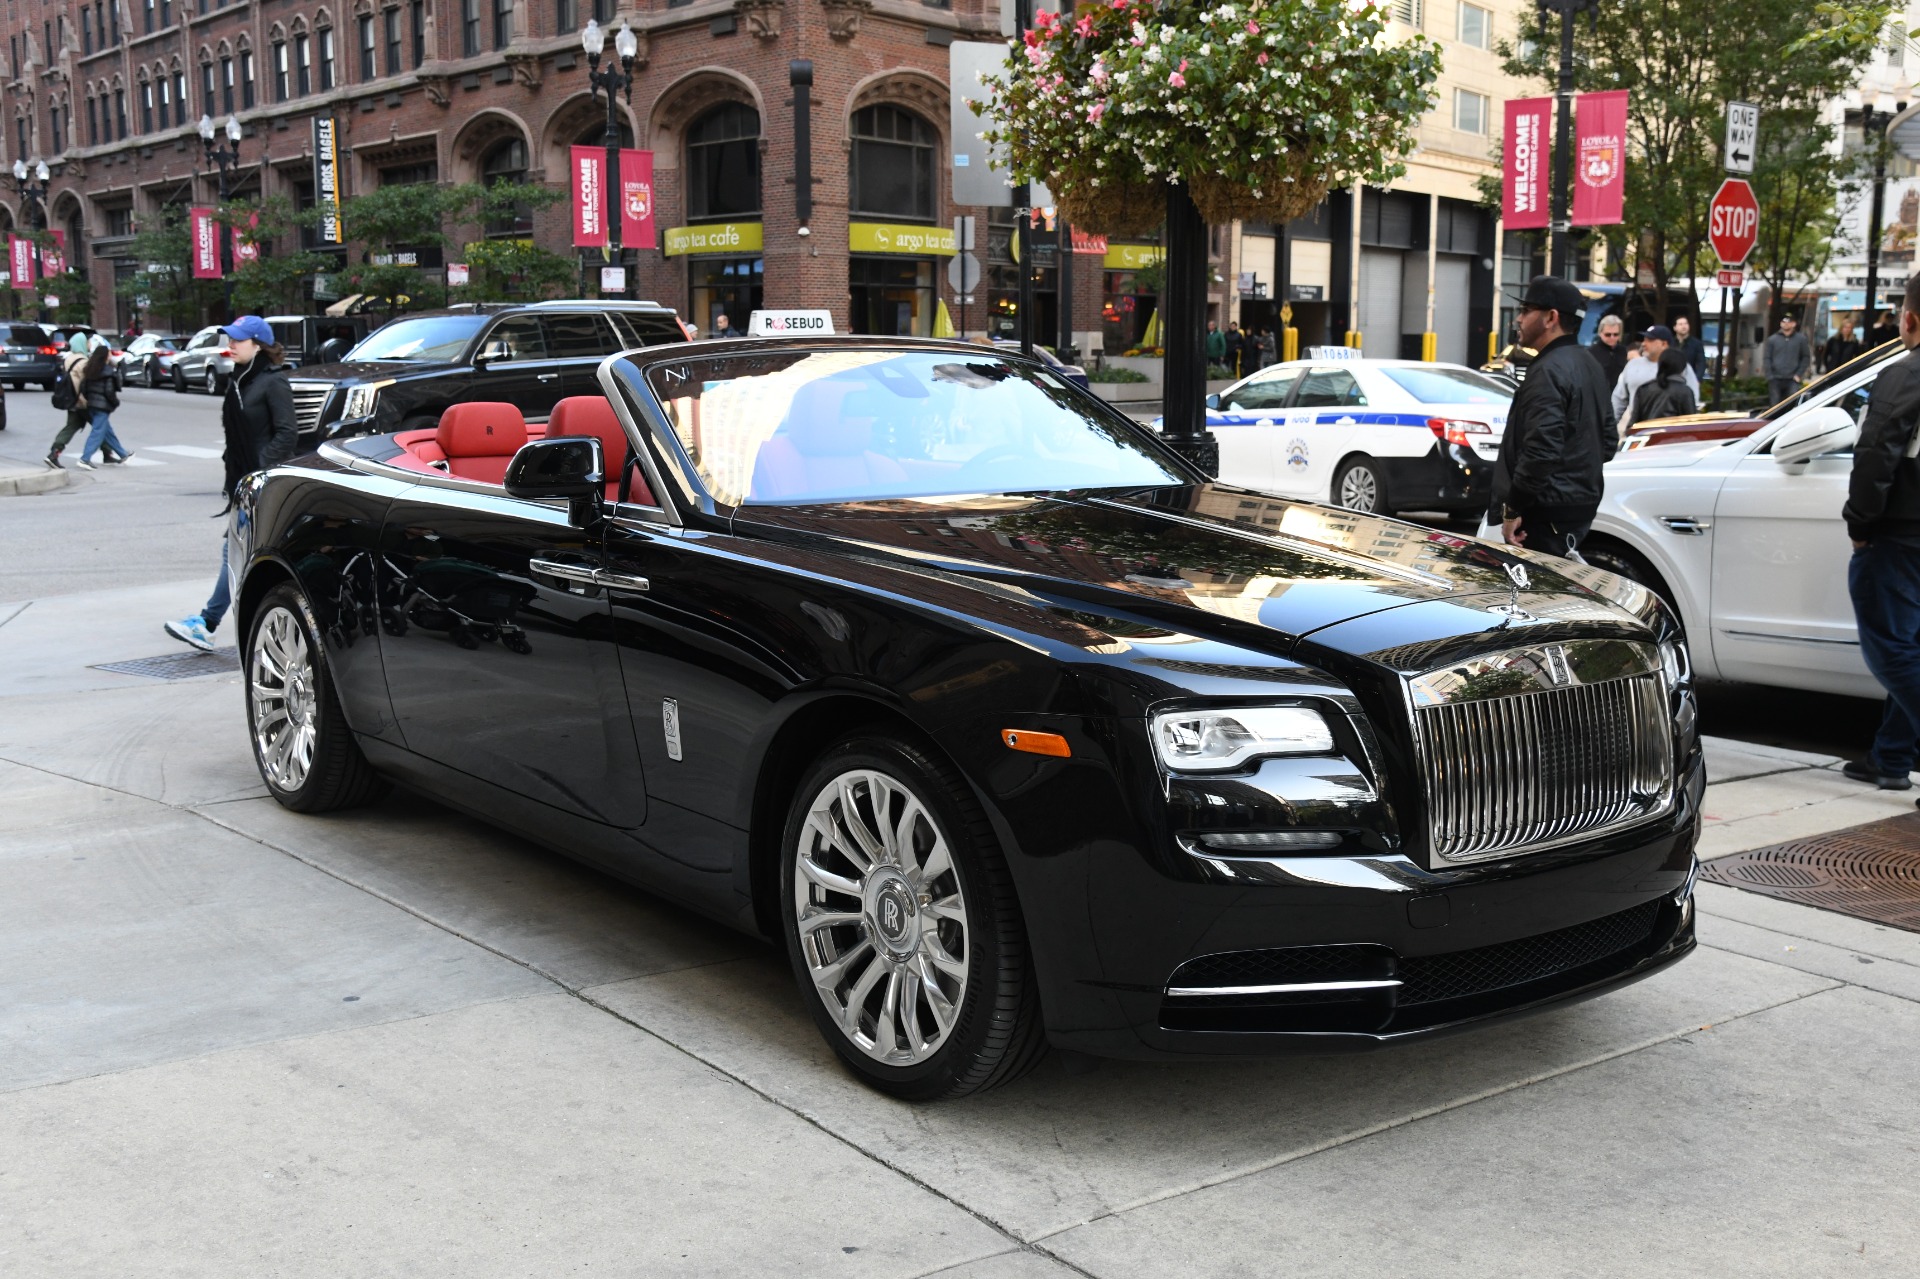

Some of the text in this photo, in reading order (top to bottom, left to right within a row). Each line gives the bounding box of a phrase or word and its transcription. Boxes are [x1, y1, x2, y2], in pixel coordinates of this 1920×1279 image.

[1732, 108, 1754, 127] ONE
[319, 119, 333, 161] BAGELS
[1582, 136, 1619, 147] LOYOLA
[1731, 128, 1753, 145] WAY
[1514, 114, 1531, 213] WELCOME
[1529, 114, 1540, 213] WATER TOWER CAMPUS
[624, 181, 650, 190] LOYOLA
[580, 158, 594, 235] WELCOME
[1712, 205, 1756, 238] STOP
[198, 216, 210, 270] WELCOME
[691, 233, 706, 247] tea
[709, 225, 740, 247] café
[896, 233, 924, 252] argo
[925, 233, 940, 249] tea
[398, 252, 417, 265] BAGELS
[1324, 348, 1349, 360] 1068
